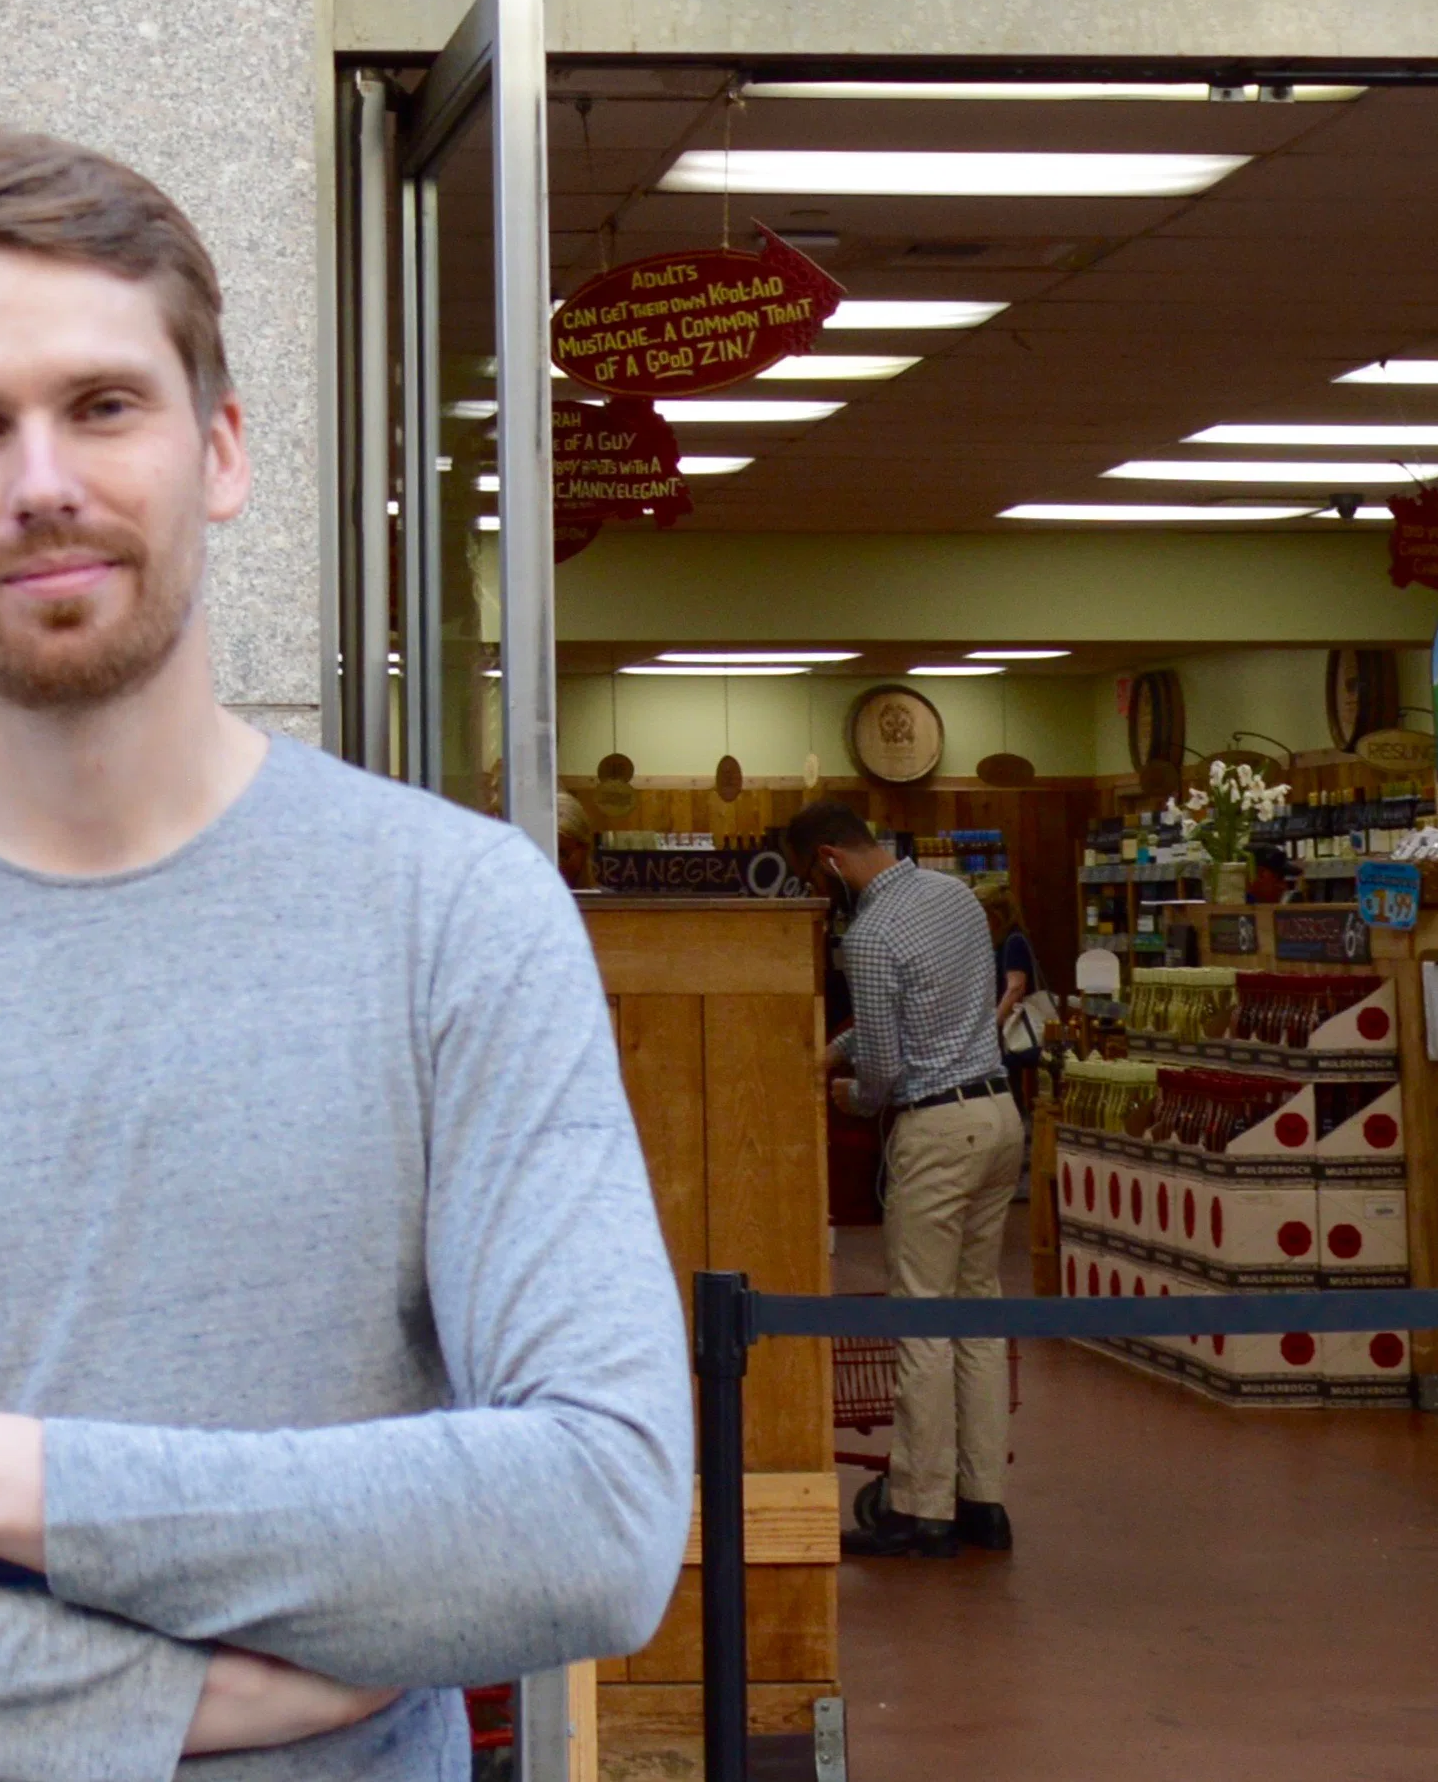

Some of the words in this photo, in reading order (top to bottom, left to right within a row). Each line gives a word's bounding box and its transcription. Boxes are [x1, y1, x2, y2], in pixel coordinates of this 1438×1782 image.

[632, 264, 699, 291] ADULTS
[563, 305, 598, 330] CAN
[600, 300, 632, 324] GET
[632, 298, 670, 320] THEIR
[671, 293, 707, 315] OWN
[664, 326, 678, 343] A
[680, 309, 760, 340] COMMON
[760, 298, 815, 327] TRAIT
[594, 355, 621, 382] OF
[625, 354, 640, 379] A
[645, 346, 695, 375] GOOD
[698, 330, 758, 367] ZIN!
[552, 410, 582, 428] RAH
[597, 430, 639, 451] GUY
